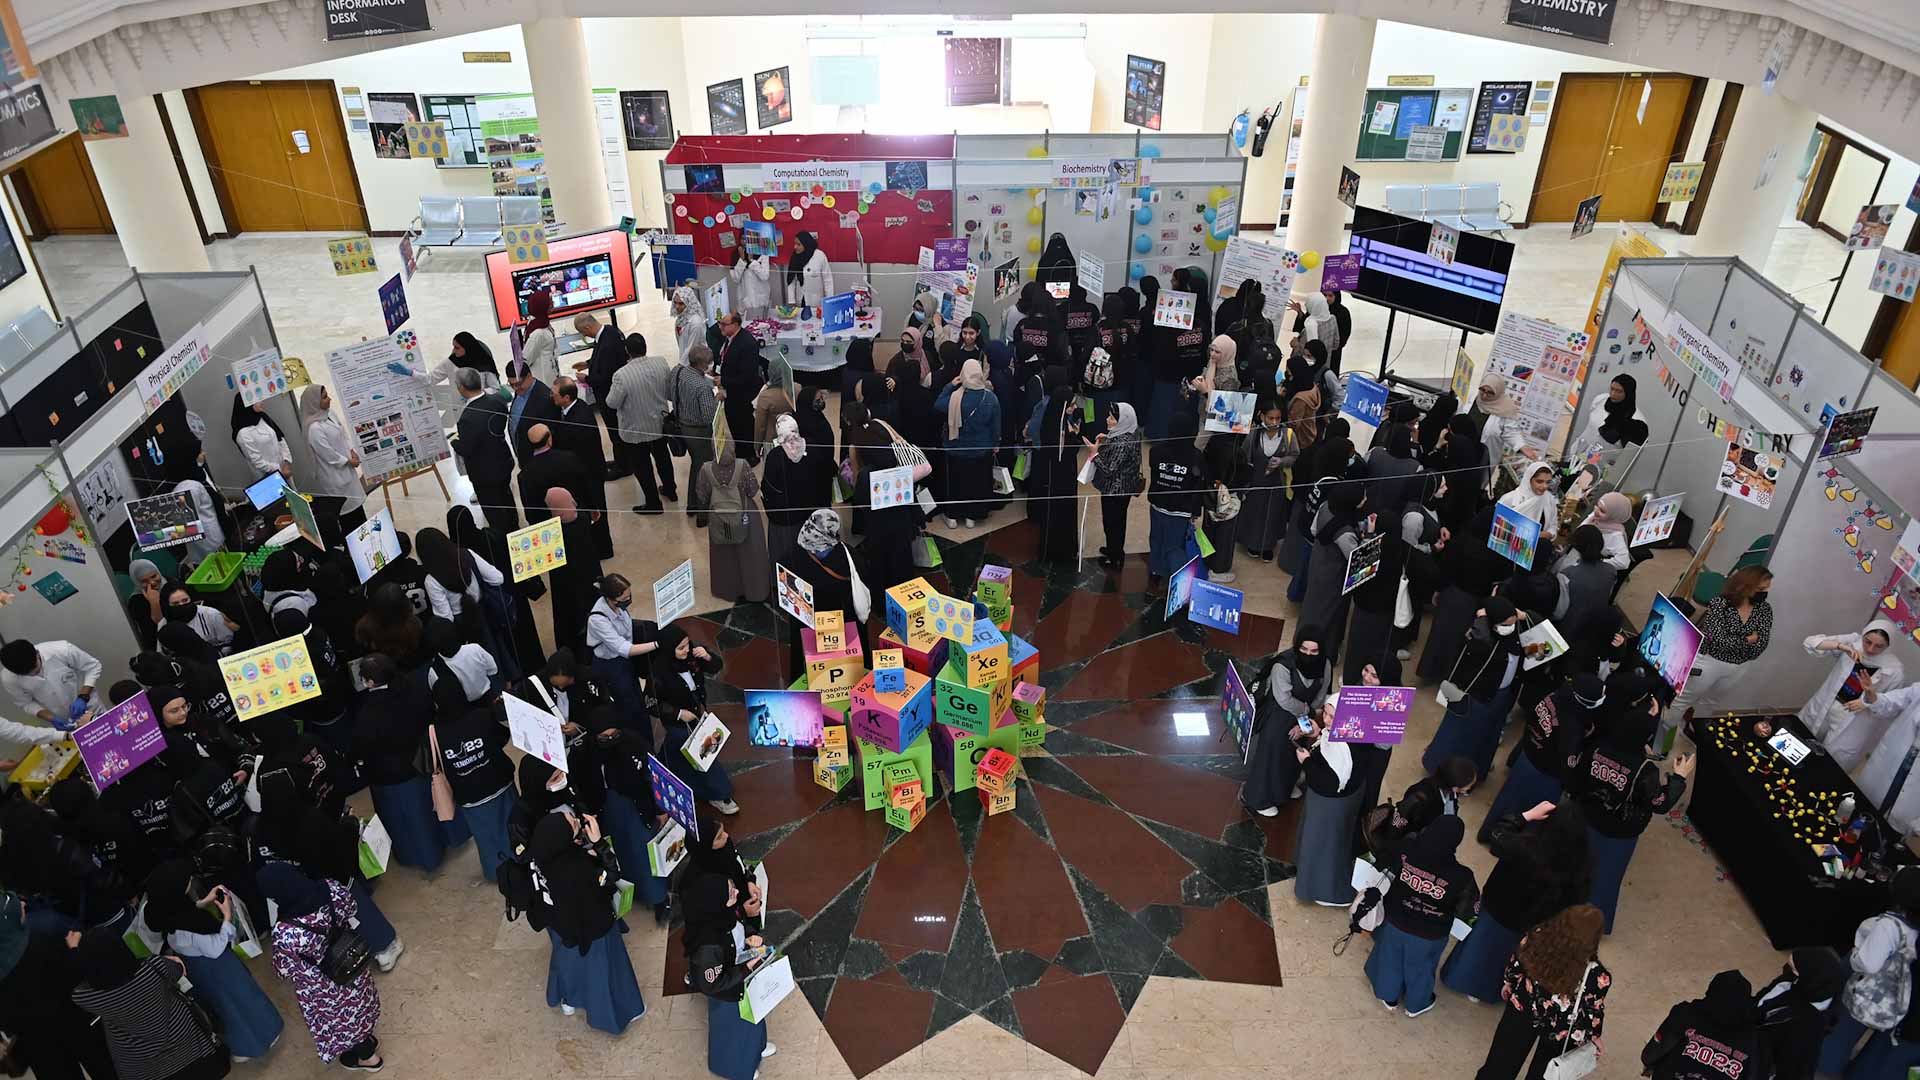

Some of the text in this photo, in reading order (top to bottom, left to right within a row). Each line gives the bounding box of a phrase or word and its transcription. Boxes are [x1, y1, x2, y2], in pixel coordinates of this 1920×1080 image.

[327, 0, 405, 11] INFORMATION
[330, 12, 358, 24] DESK
[774, 168, 849, 178] Computational Chemistry
[1062, 164, 1107, 175] Biochemistry
[1677, 323, 1730, 378] Inorganic Chemistry
[148, 339, 198, 387] Physical Chemistry
[1698, 406, 1793, 453] CHEMISTRY
[141, 542, 166, 553] CHEMISTRY
[907, 590, 926, 601] Br
[985, 587, 996, 596] Er
[909, 610, 921, 620] 106
[823, 635, 839, 644] Hg
[811, 662, 825, 671] 15
[978, 657, 998, 671] Xe
[829, 669, 844, 683] P
[882, 674, 897, 682] Fe
[940, 683, 953, 694] 32
[208, 692, 227, 709] 23
[853, 696, 866, 706] 19
[949, 695, 978, 715] Ge
[910, 703, 920, 721] Y
[867, 709, 882, 728] K
[1025, 729, 1039, 739] Nd
[960, 741, 975, 750] 58
[826, 751, 841, 759] Zn
[970, 747, 1004, 765] C
[867, 760, 882, 770] 57
[892, 768, 912, 777] Pm
[1591, 760, 1628, 792] 2023
[982, 773, 998, 786] Mc
[902, 787, 914, 797] Bi
[996, 794, 1010, 805] Bh
[1400, 868, 1446, 900] 2023
[1682, 1041, 1744, 1080] 2023
